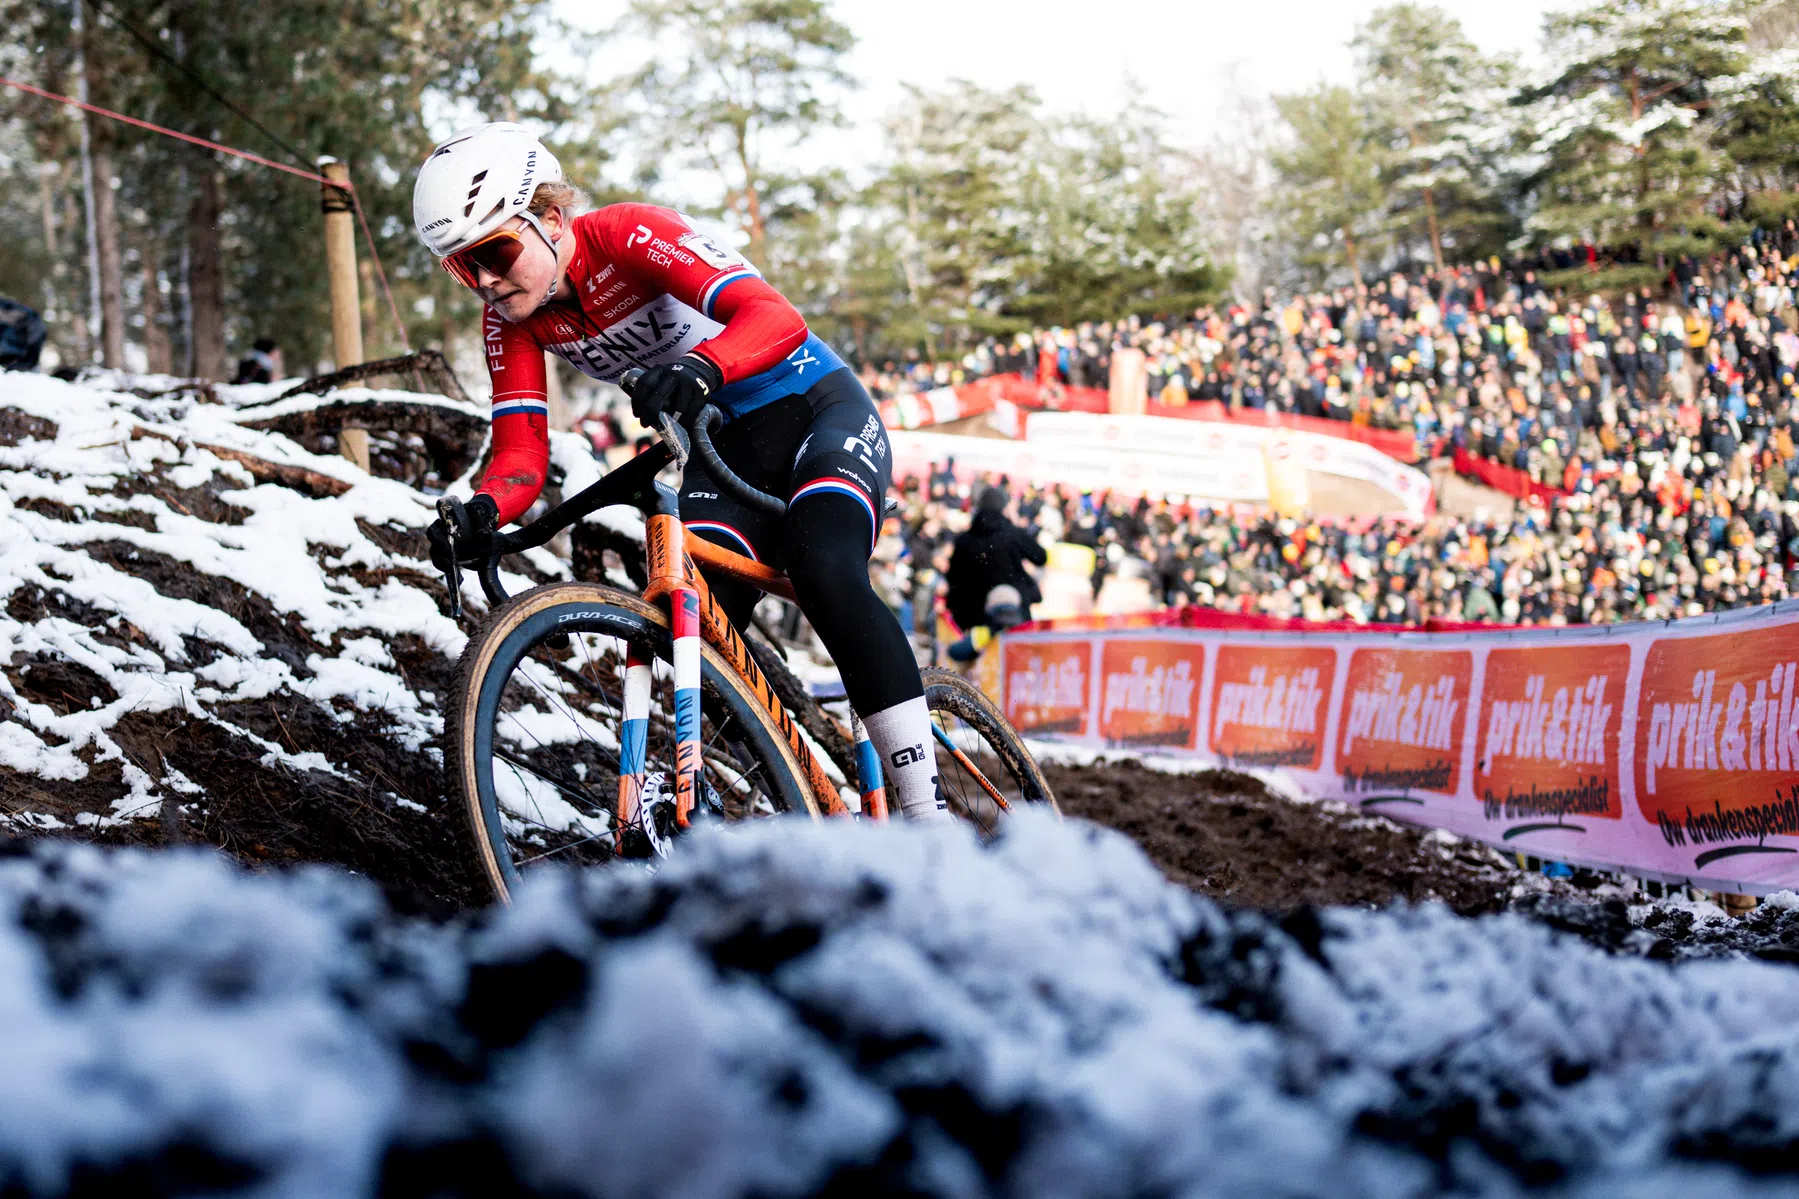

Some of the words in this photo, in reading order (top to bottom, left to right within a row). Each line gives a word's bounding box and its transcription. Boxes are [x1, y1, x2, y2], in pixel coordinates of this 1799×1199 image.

[513, 151, 537, 206] CANYON
[422, 217, 453, 233] CANYON
[647, 248, 673, 269] TECH
[650, 237, 695, 267] PREMIER
[593, 280, 628, 306] CANYON
[603, 294, 641, 320] SKODA
[486, 306, 505, 372] FENI
[636, 323, 692, 363] MATERIALS
[837, 466, 872, 493] wahoo
[654, 522, 667, 569] CANYON
[558, 611, 642, 629] DURA-ACE
[1215, 665, 1323, 742] prik&tik
[1343, 671, 1459, 756] prik&tik
[677, 695, 693, 794] CANYON
[1482, 675, 1613, 777] prik&tik
[1646, 662, 1799, 795] prik&tik
[1484, 787, 1501, 821] Uw
[1505, 775, 1610, 826] drankenspecialist
[1657, 808, 1687, 847] Uw
